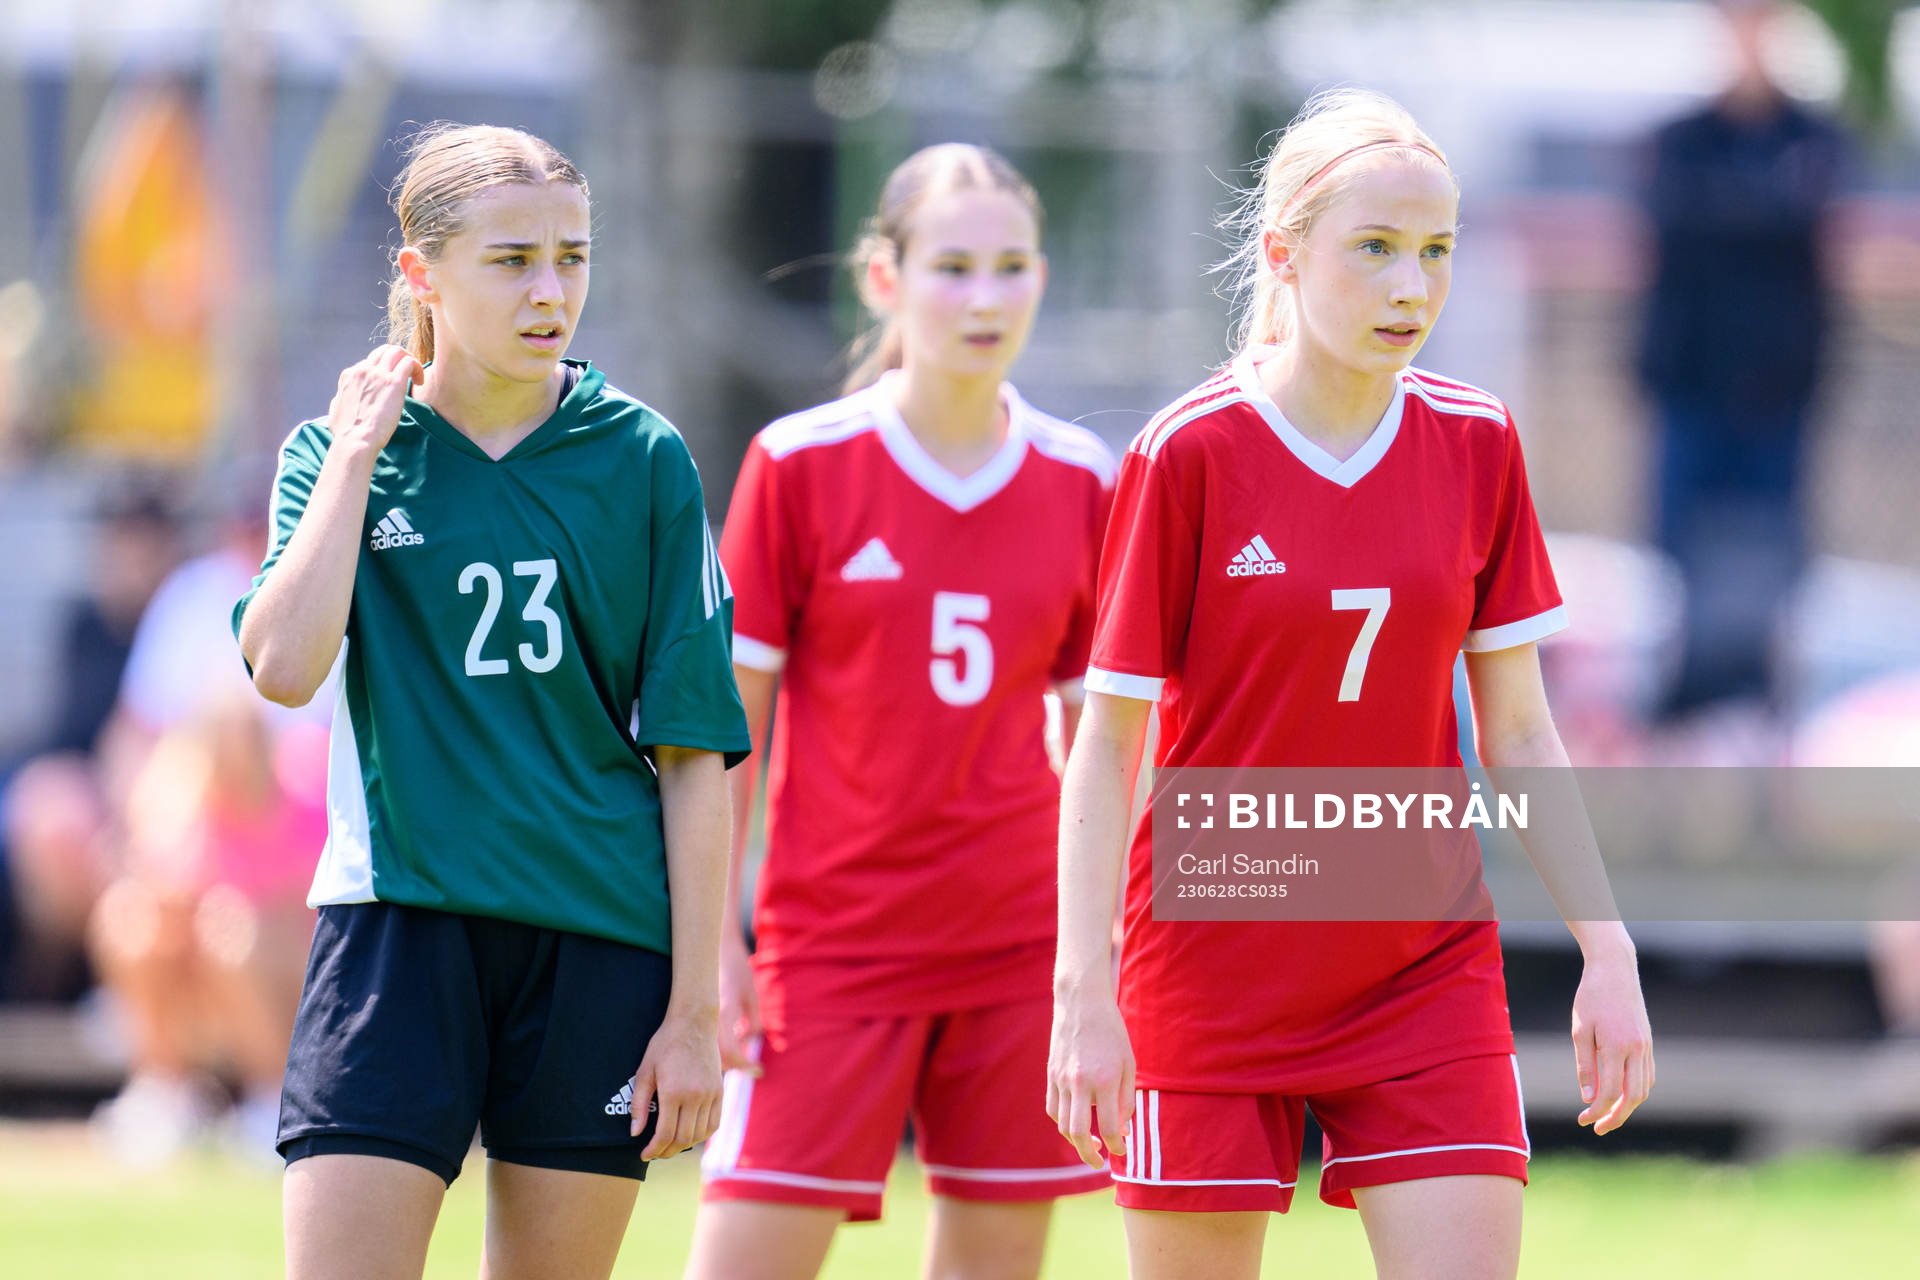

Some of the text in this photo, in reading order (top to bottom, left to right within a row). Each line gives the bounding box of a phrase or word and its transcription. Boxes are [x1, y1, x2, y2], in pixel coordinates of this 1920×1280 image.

[370, 532, 425, 551] adidas
[1226, 560, 1286, 577] adidas
[458, 558, 563, 677] 23
[929, 591, 995, 706] 5
[1331, 587, 1391, 703] 7
[604, 1100, 657, 1115] adis
